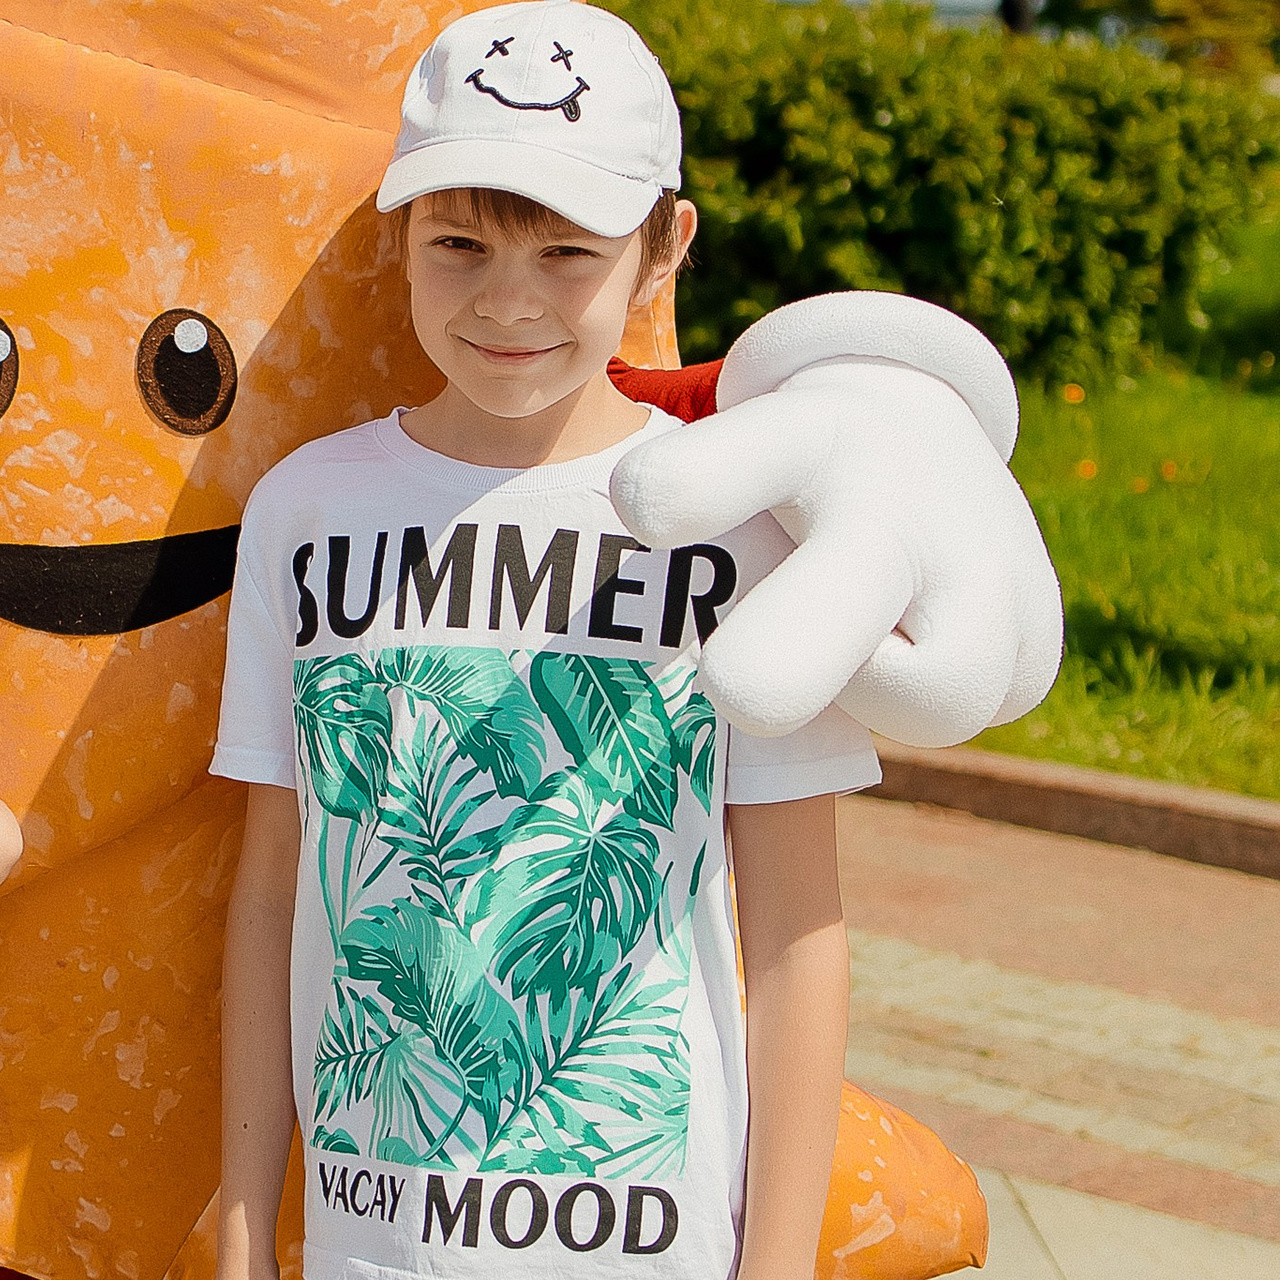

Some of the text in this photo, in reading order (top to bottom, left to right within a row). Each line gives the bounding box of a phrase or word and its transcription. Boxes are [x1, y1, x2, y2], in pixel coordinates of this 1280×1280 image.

[292, 523, 738, 650] SUMMER
[318, 1162, 680, 1255] VACAY MOOD
